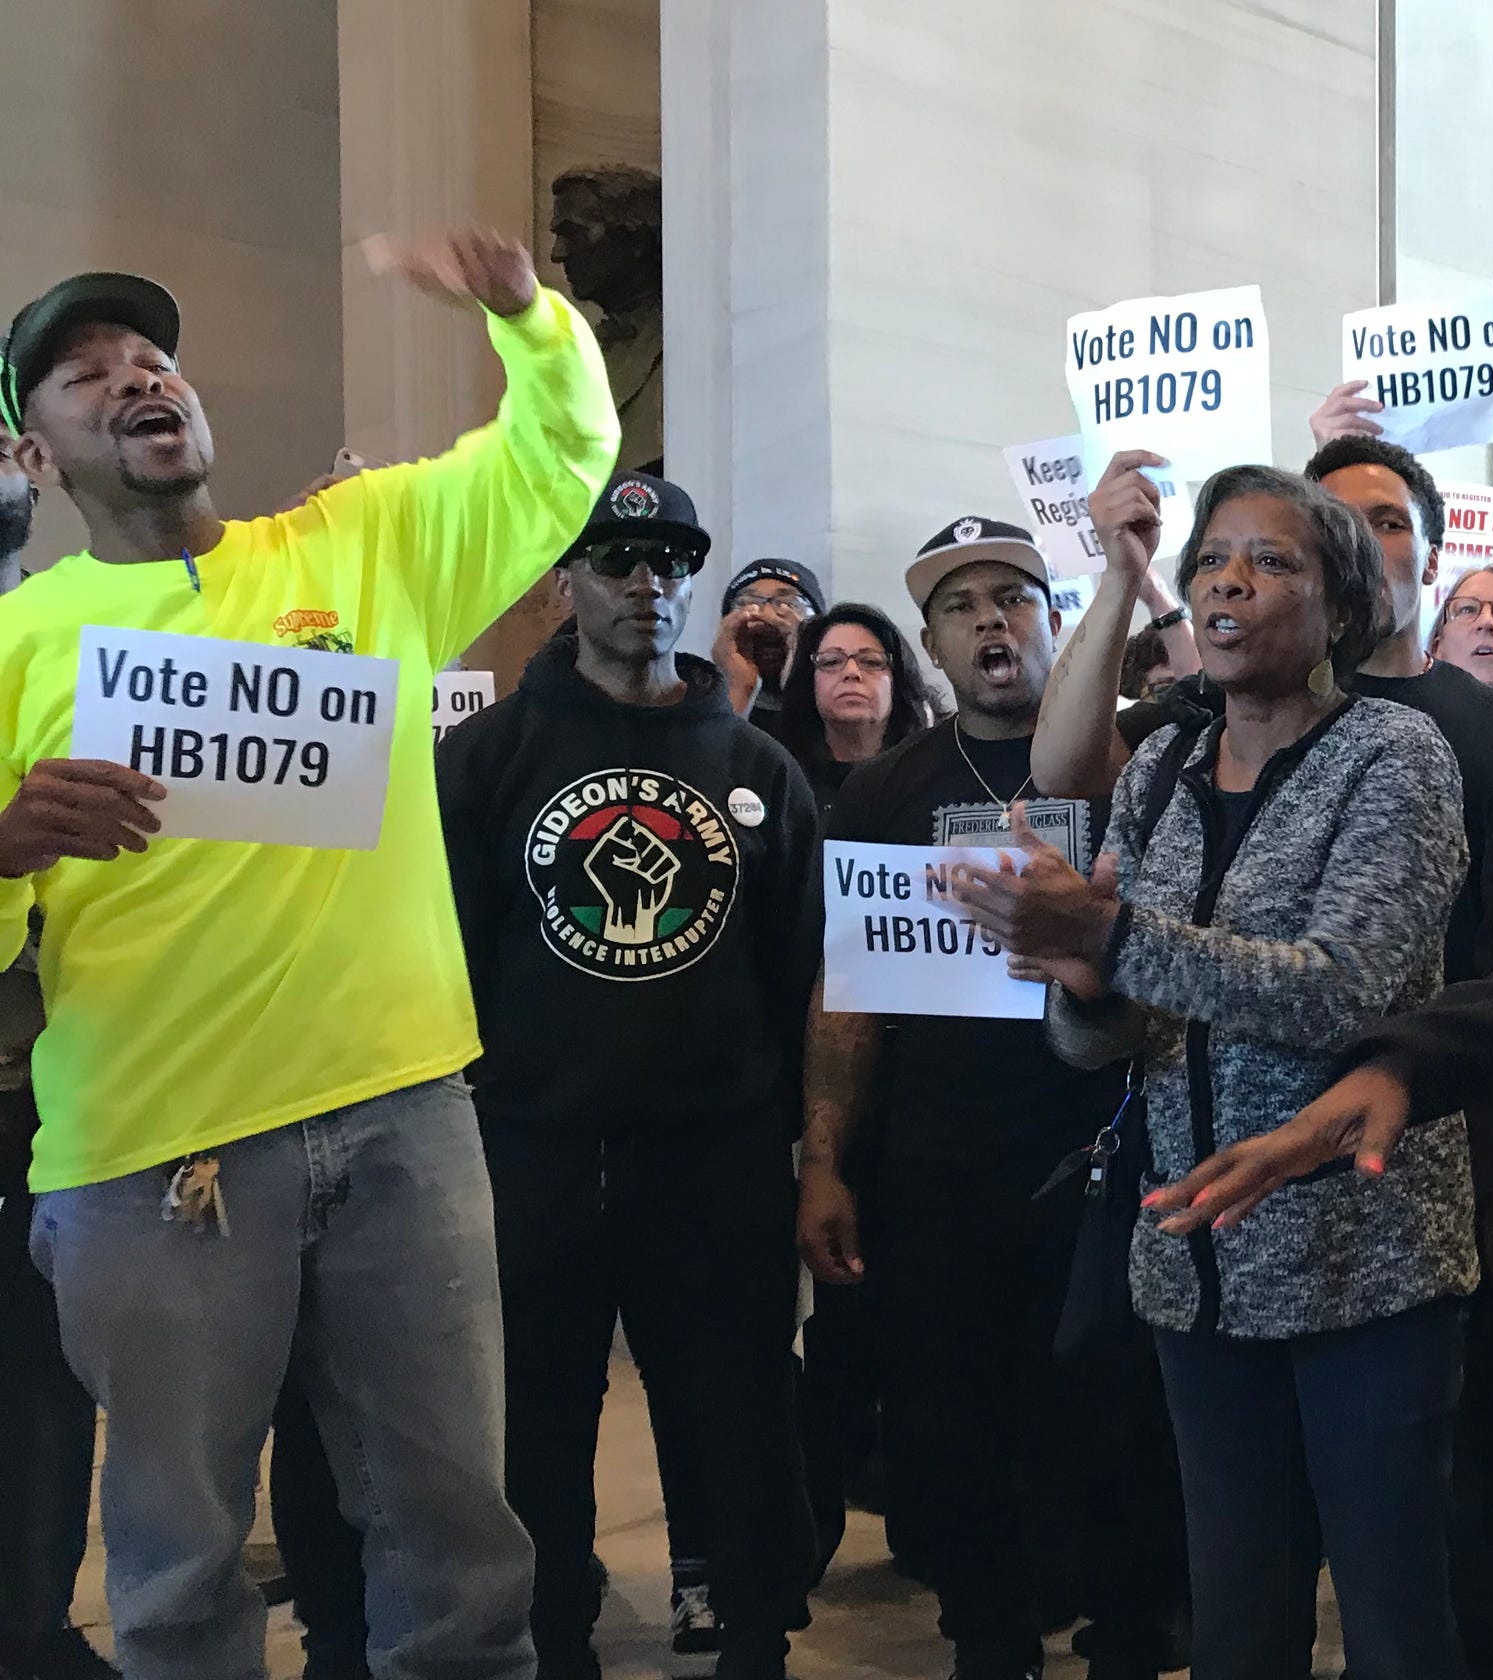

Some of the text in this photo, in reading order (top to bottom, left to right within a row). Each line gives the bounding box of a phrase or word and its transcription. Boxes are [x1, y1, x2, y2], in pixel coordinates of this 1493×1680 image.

[1073, 312, 1254, 371] Vote NO on
[1352, 325, 1416, 360] Vote
[1428, 315, 1471, 353] NO
[1094, 369, 1222, 425] HB1079
[1022, 455, 1082, 486] Keep
[1448, 507, 1489, 531] NOT
[1462, 493, 1491, 503] REGISTER
[97, 647, 208, 708] Vote
[229, 662, 300, 718] NO
[320, 686, 377, 725] on
[451, 691, 483, 712] on
[130, 724, 329, 788] HB1079
[532, 776, 733, 867] GIDEON'S ARMY
[952, 817, 1010, 834] FREDERI
[835, 857, 911, 900] Vote
[615, 888, 725, 965] INTERRUPTER
[864, 915, 1002, 957] HB1079
